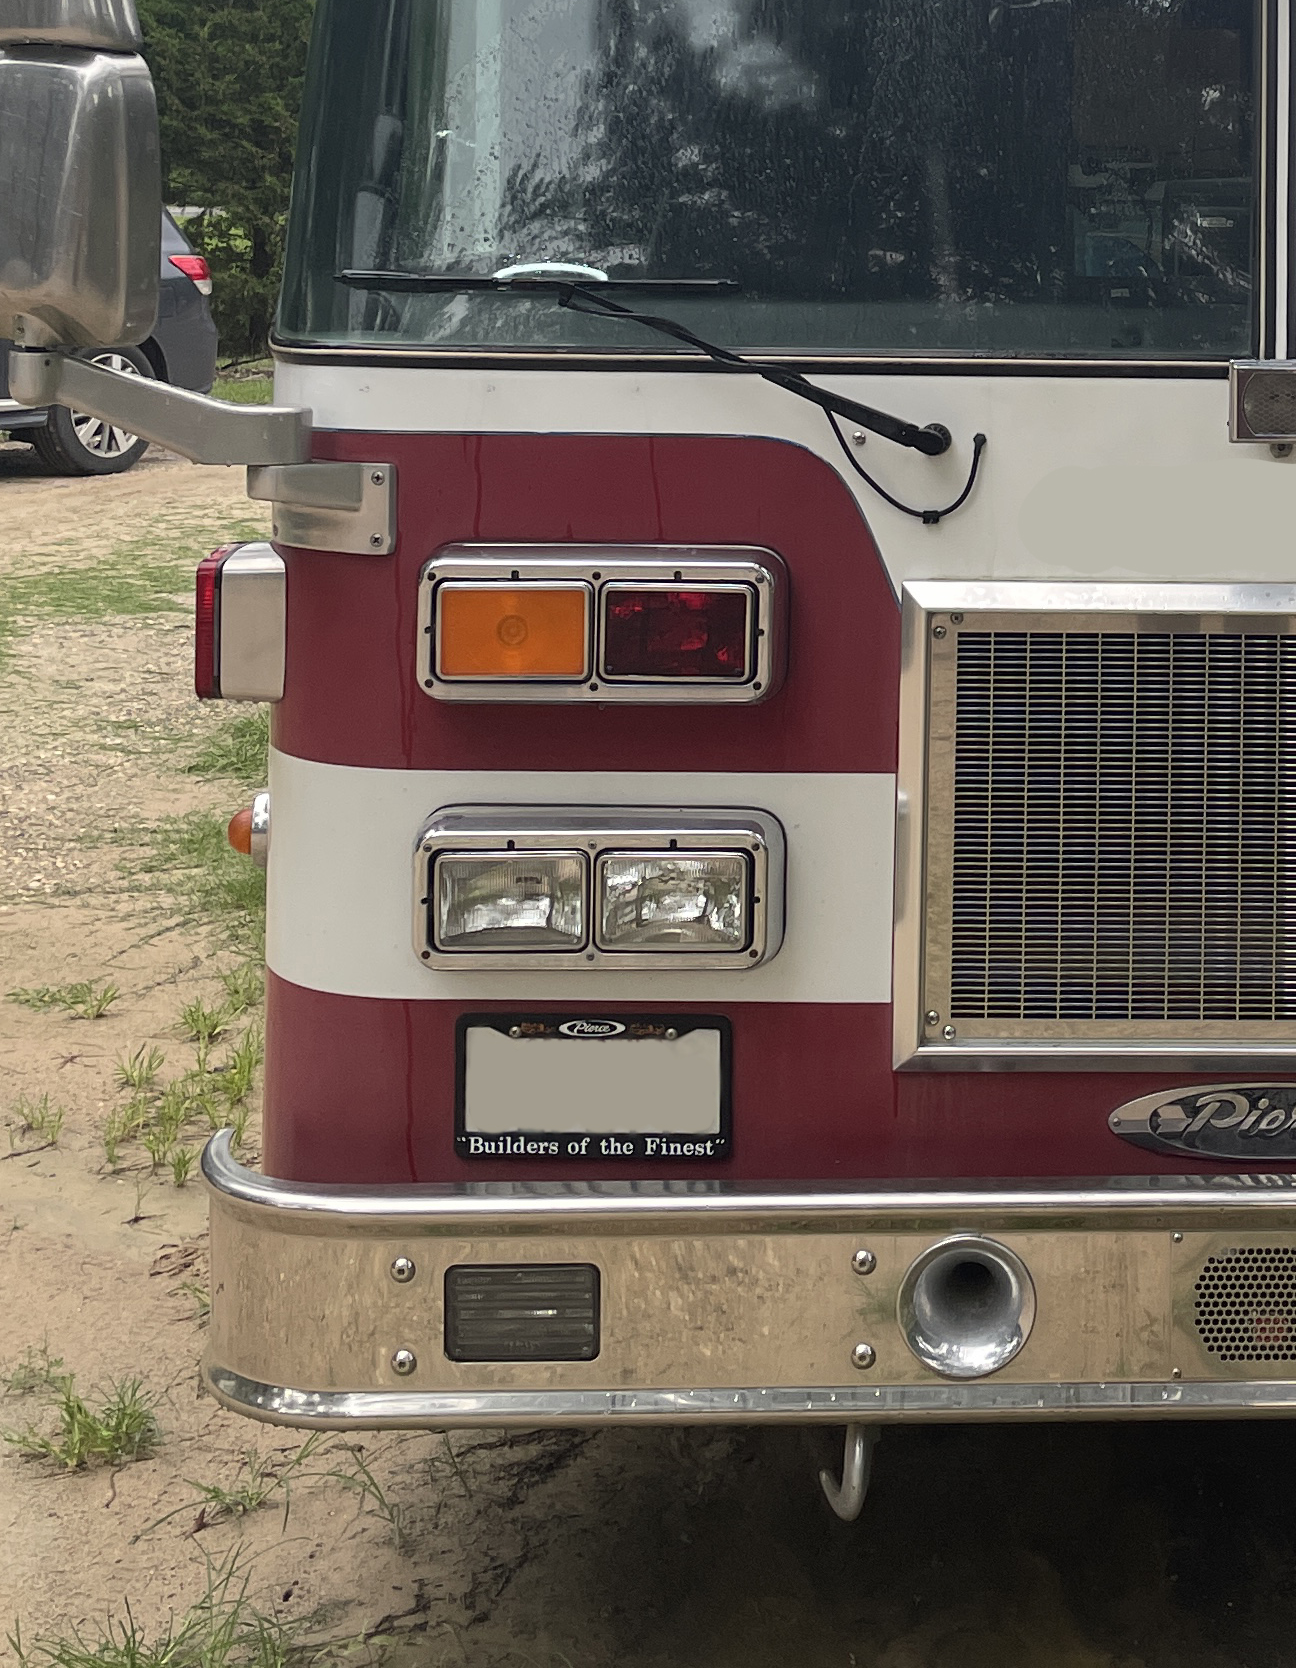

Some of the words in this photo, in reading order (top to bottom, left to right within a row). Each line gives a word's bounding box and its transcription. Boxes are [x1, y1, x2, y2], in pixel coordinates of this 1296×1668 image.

[573, 1022, 611, 1034] Pierce
[567, 1137, 591, 1155] of
[600, 1137, 634, 1155] the
